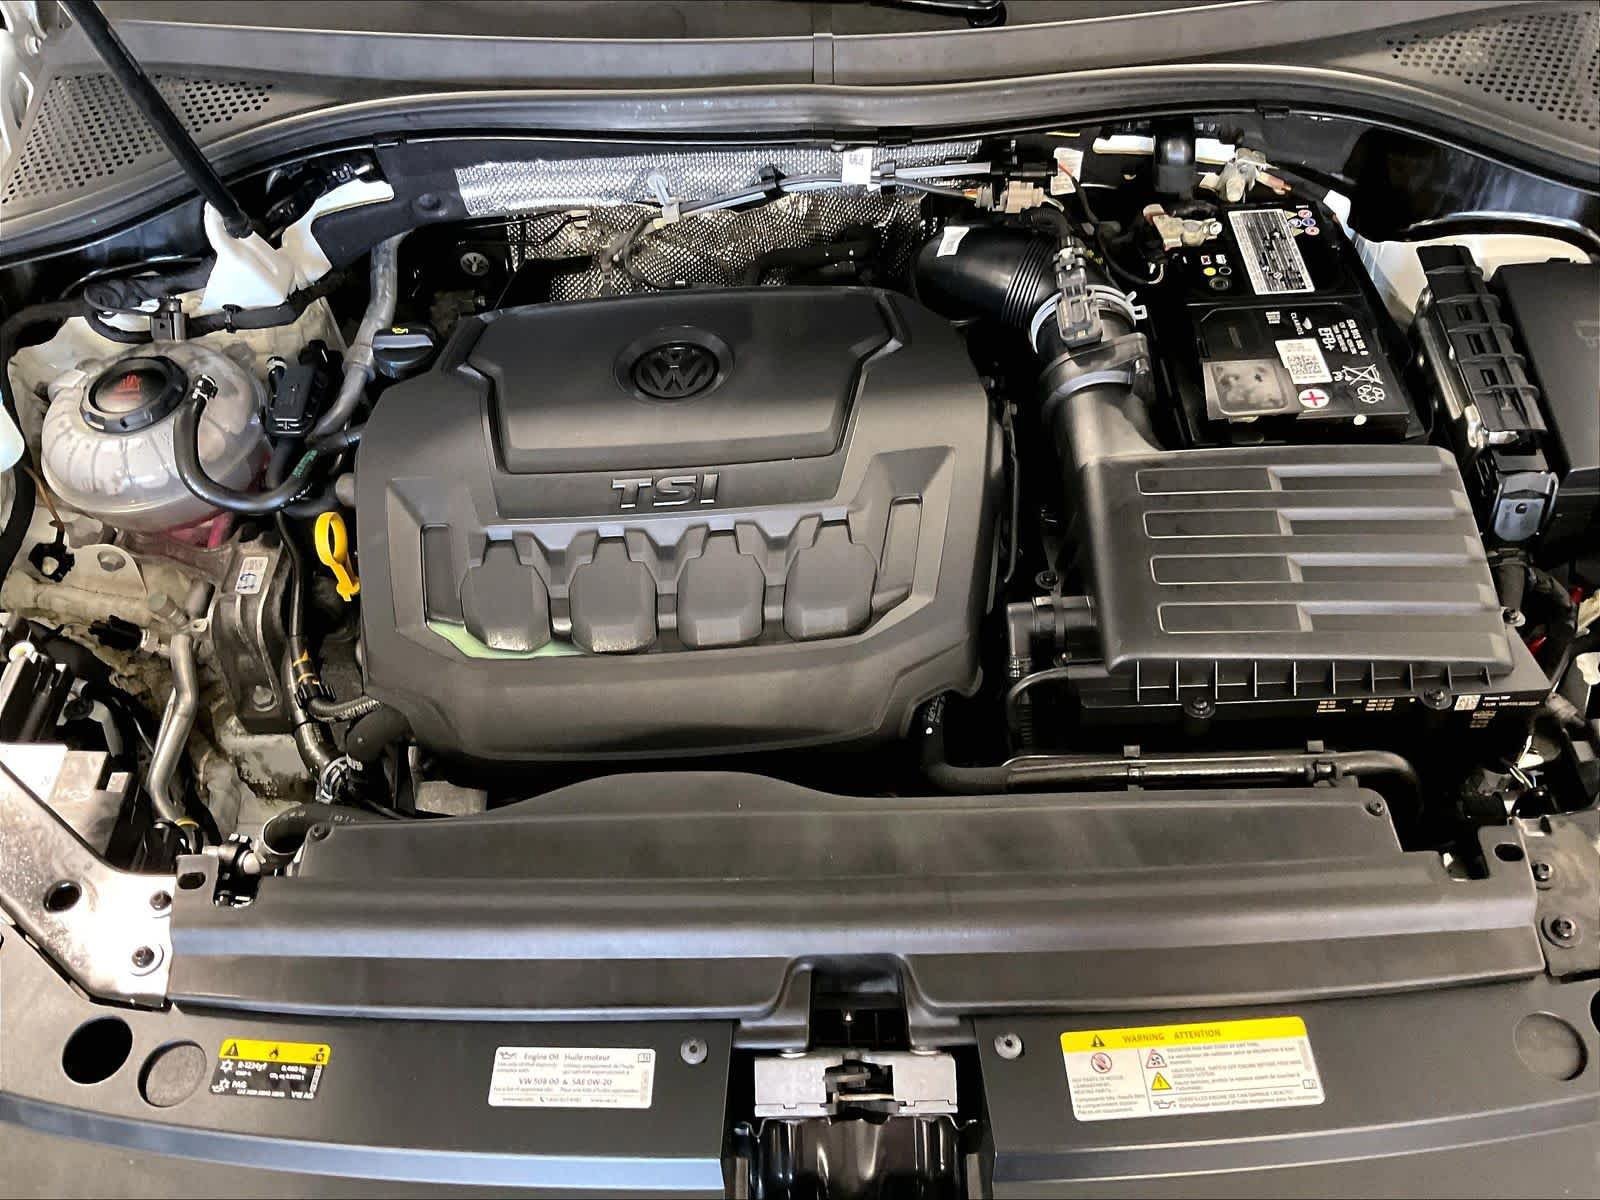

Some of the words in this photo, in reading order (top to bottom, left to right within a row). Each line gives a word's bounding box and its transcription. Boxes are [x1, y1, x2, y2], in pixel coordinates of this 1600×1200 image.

[1318, 327, 1336, 351] EFB+
[612, 473, 719, 508] TSI
[1121, 1032, 1165, 1044] WARNING
[1173, 1028, 1222, 1040] ATTENTION
[523, 1053, 548, 1063] Engine
[564, 1053, 583, 1062] Huile
[584, 1053, 611, 1062] moteur
[519, 1077, 533, 1085] VW
